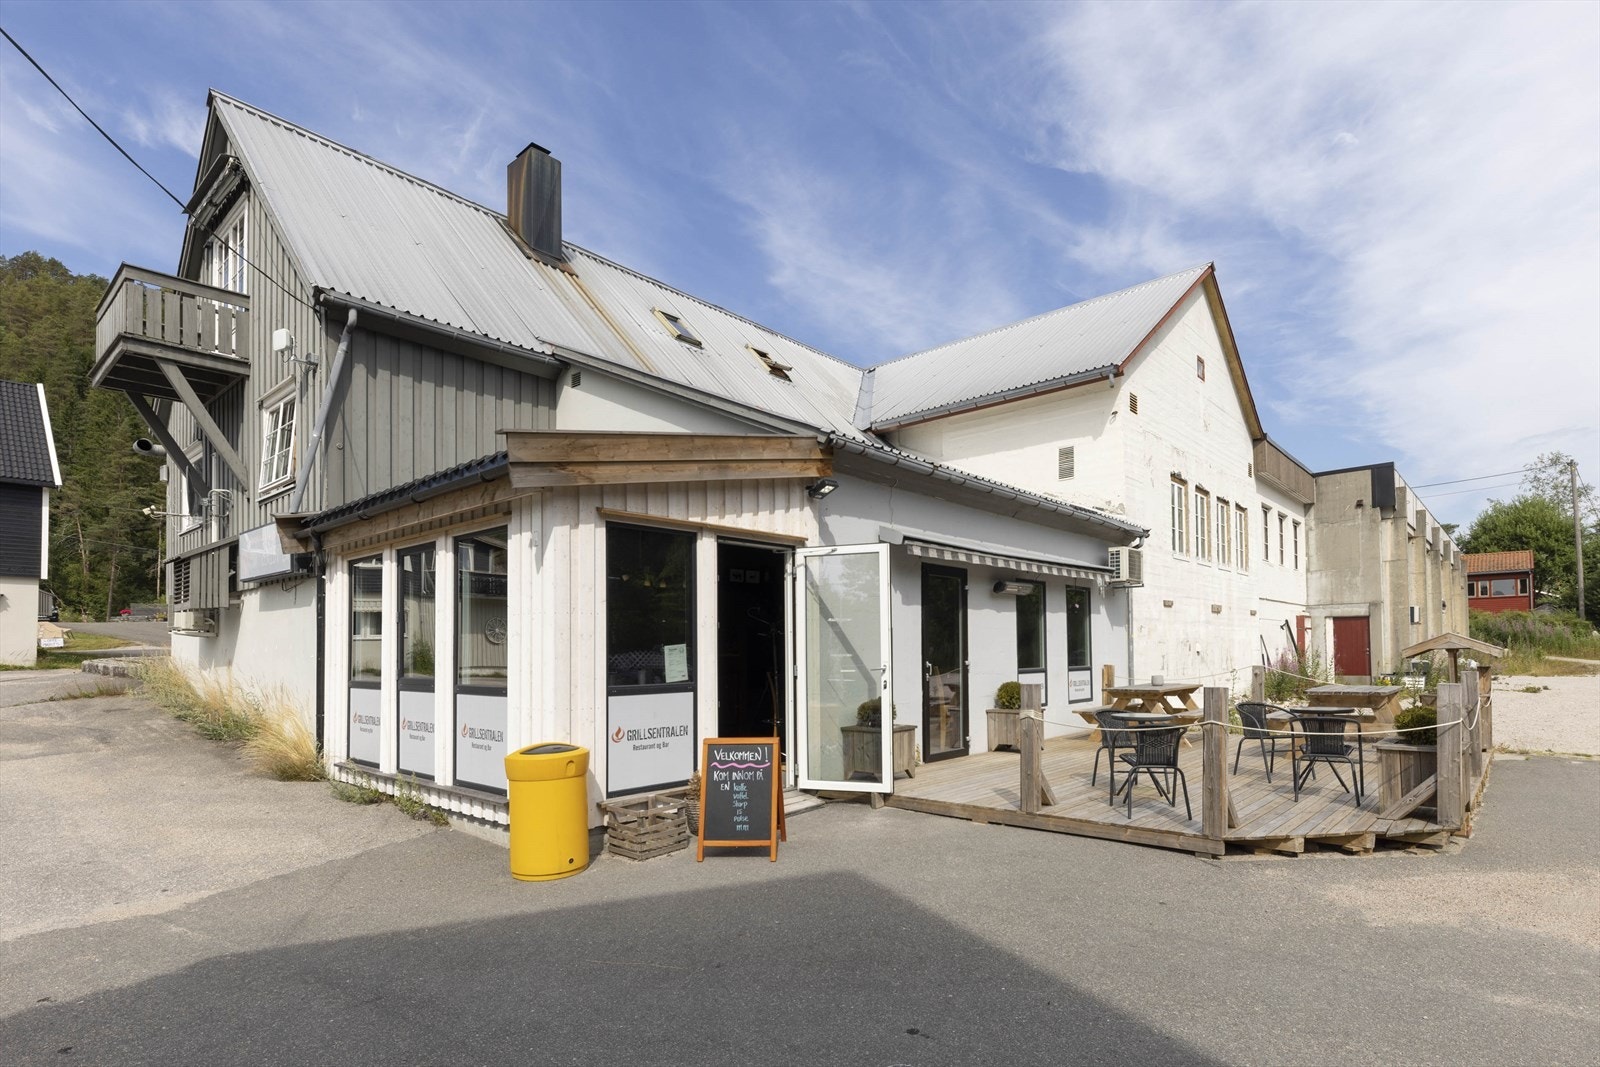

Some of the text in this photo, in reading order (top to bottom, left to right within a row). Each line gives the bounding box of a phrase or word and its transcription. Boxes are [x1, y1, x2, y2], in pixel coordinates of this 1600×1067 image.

[626, 725, 689, 741] GRILLSENTRALEN
[633, 743, 656, 751] Restaurant
[713, 768, 764, 781] KOM INNOM PÅ
[720, 781, 731, 790] EN
